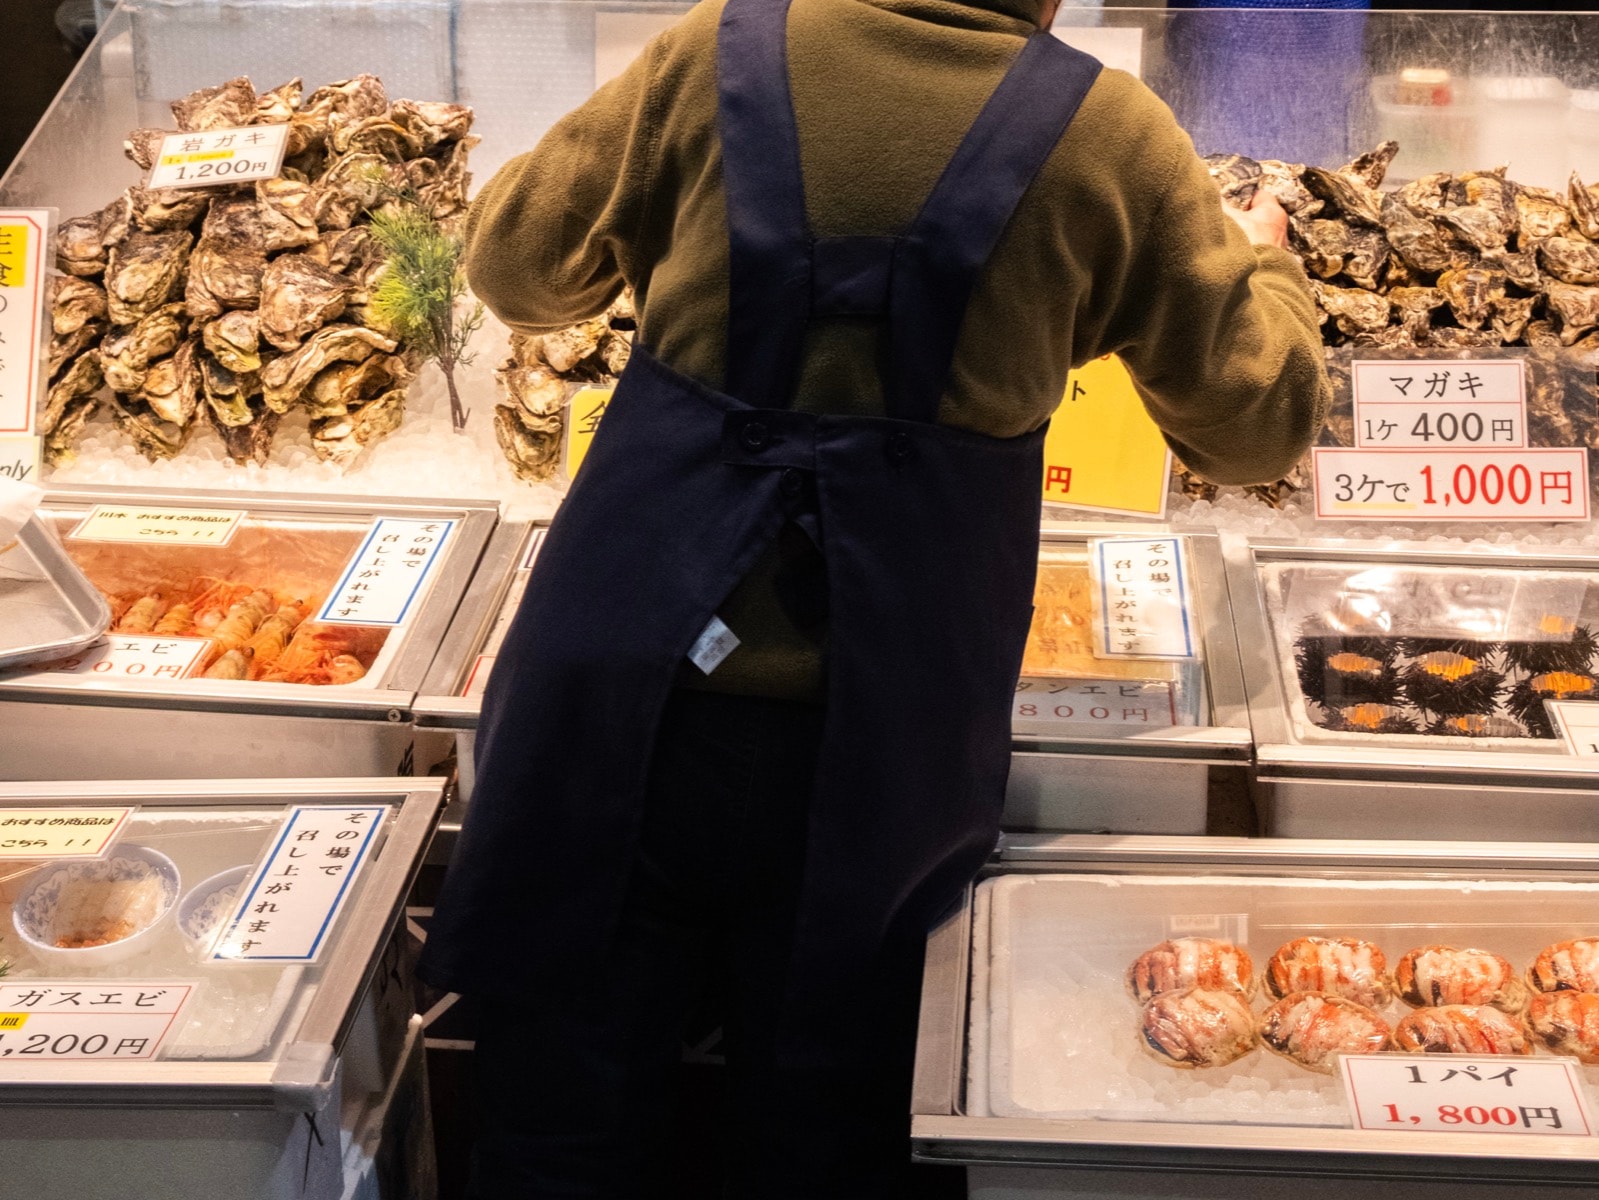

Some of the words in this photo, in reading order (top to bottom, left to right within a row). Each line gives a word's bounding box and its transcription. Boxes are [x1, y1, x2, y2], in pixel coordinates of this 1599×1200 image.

[180, 132, 266, 152] 岩ガキ
[175, 159, 267, 180] 1,200円
[1389, 371, 1484, 399] マガキ
[1410, 412, 1514, 442] 400円
[1420, 463, 1572, 507] 1,000円
[139, 528, 178, 536] こちら
[402, 524, 439, 568] その場で
[1114, 559, 1141, 651] 召し上がれます
[1, 817, 116, 826] おすすめ商品は
[1, 839, 48, 848] こちら
[318, 812, 368, 876] その場で
[240, 829, 320, 953] 召し上がれます
[9, 989, 167, 1007] ガスエビ
